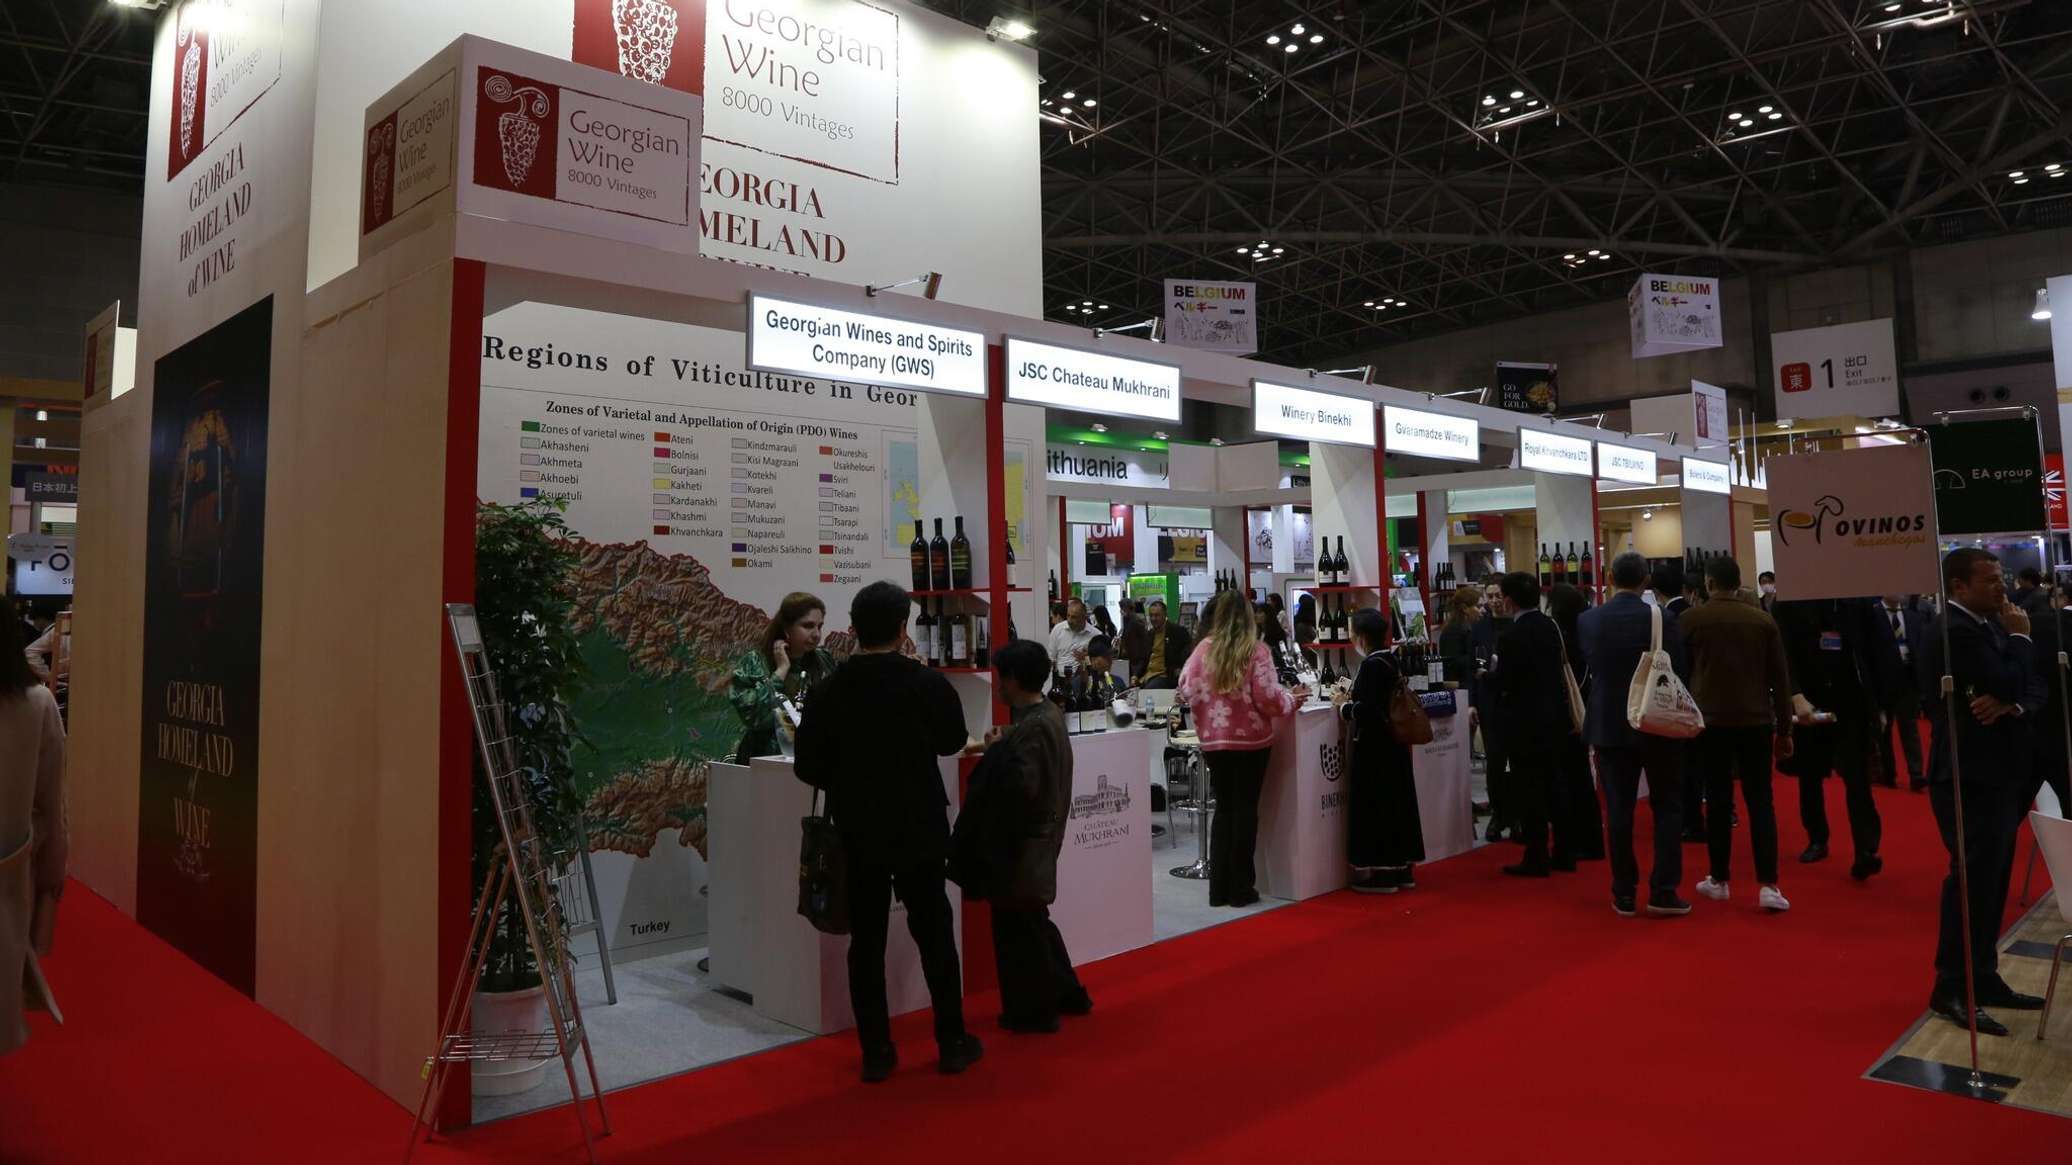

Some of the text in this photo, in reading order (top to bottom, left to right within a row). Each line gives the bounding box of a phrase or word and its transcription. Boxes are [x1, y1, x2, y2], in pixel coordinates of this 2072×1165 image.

[725, 0, 884, 71] Georgian
[722, 34, 820, 97] Wine
[400, 97, 449, 143] Georgian
[721, 86, 855, 141] 8000 Vintages
[570, 109, 680, 156] Georgian
[569, 138, 634, 174] Wine
[189, 142, 244, 212] GEORGIA
[568, 168, 657, 200] 8000 Vintages
[179, 182, 251, 262] HOMELAND
[188, 238, 236, 298] of WINE
[1174, 285, 1245, 300] BELGIUM
[1651, 280, 1711, 295] BELGIUM
[1174, 302, 1218, 313] ベルギー
[766, 309, 973, 357] Georgian Wines and Spirits
[483, 335, 608, 372] Regions
[626, 356, 655, 377] of
[671, 358, 816, 395] Viticulture
[830, 379, 852, 399] in
[812, 344, 935, 380] Company (GWS)
[1821, 358, 1834, 389] 1
[1845, 355, 1868, 368] 出口
[1018, 361, 1171, 400] JSC Chateau Mukhrani
[1845, 369, 1862, 379] Exit
[1503, 383, 1517, 392] GO
[1504, 392, 1521, 400] FOR
[546, 400, 858, 440] Zones of Varietal and Appellation of Origin (PDO) Wines
[1281, 404, 1352, 427] Winery Binekhi
[541, 423, 645, 441] Zones of varietal wines
[671, 434, 694, 446] Ateni
[1395, 422, 1469, 446] Gvaramadze Winery
[541, 439, 590, 453] Akhasheni
[671, 449, 699, 461] Bolnisi
[541, 456, 583, 469] Akhmeta
[670, 465, 707, 477] Gurjaani
[1047, 450, 1128, 480] ithuania
[1971, 468, 2033, 480] EA group
[540, 472, 579, 485] Akhoebi
[670, 480, 702, 491] Kakheti
[670, 495, 718, 506] Kardanakhi
[670, 510, 707, 522] Khashmi
[1835, 514, 1926, 537] OVINOS
[670, 525, 724, 537] Khvanchkara
[747, 559, 773, 569] Okami
[166, 680, 225, 726] GEORGIA
[158, 723, 234, 777] HOMELAND
[174, 797, 211, 849] WINE
[1074, 824, 1130, 845] MUKHRANI
[630, 920, 671, 936] Turkey
